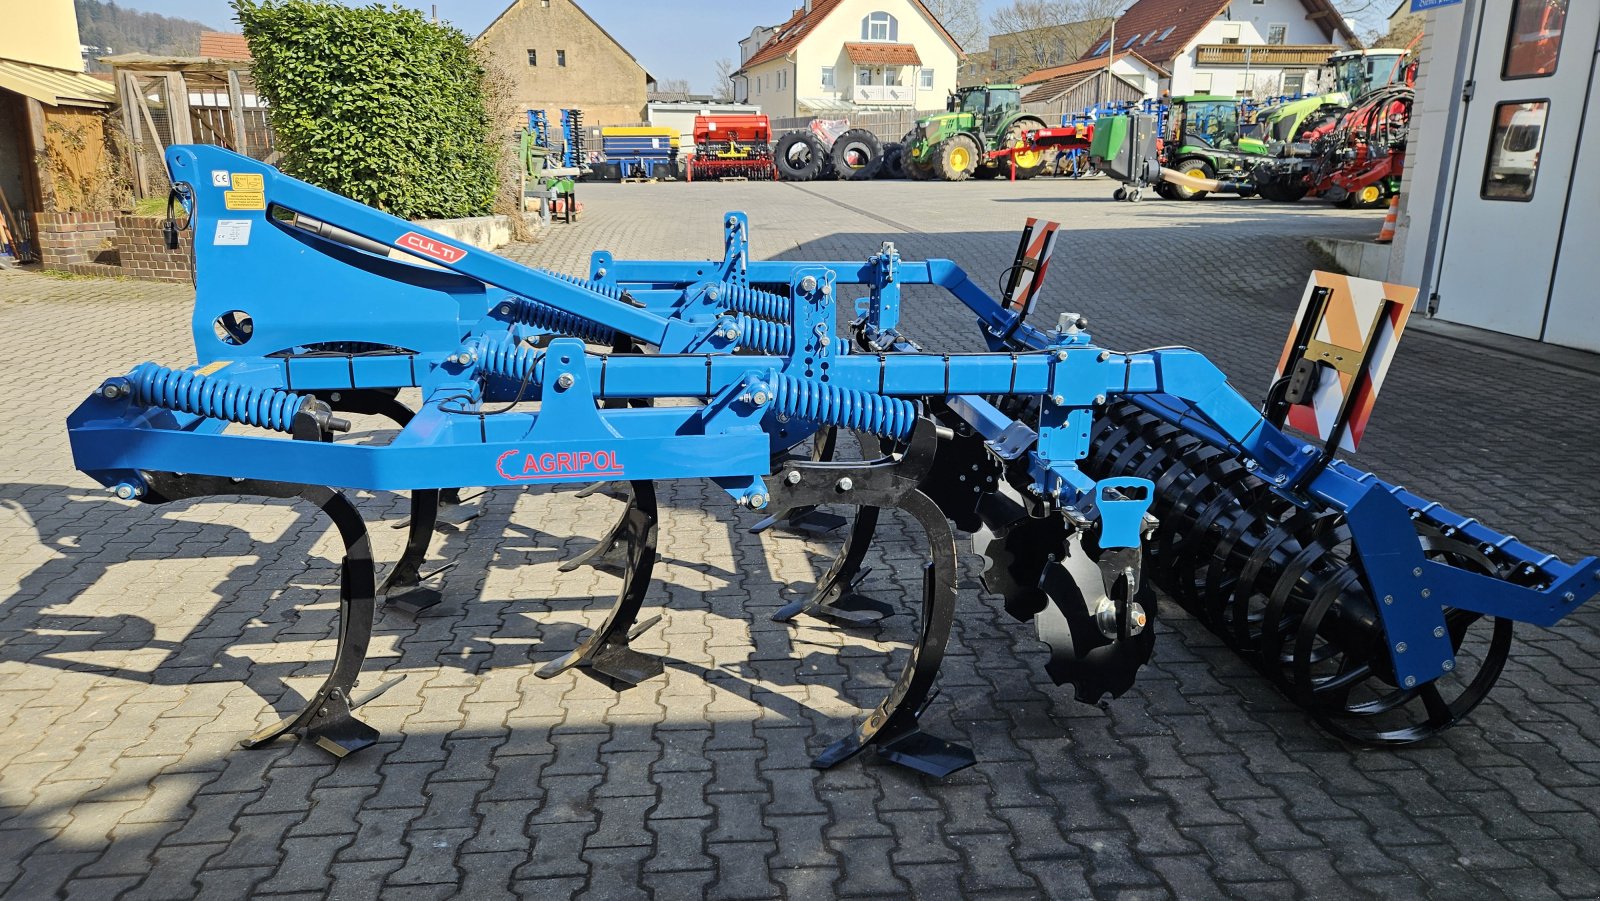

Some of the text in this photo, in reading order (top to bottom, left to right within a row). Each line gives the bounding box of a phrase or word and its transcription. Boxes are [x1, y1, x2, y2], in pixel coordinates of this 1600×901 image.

[215, 174, 228, 183] CE
[408, 236, 455, 259] CULTI
[523, 450, 624, 473] AGRIPOL
